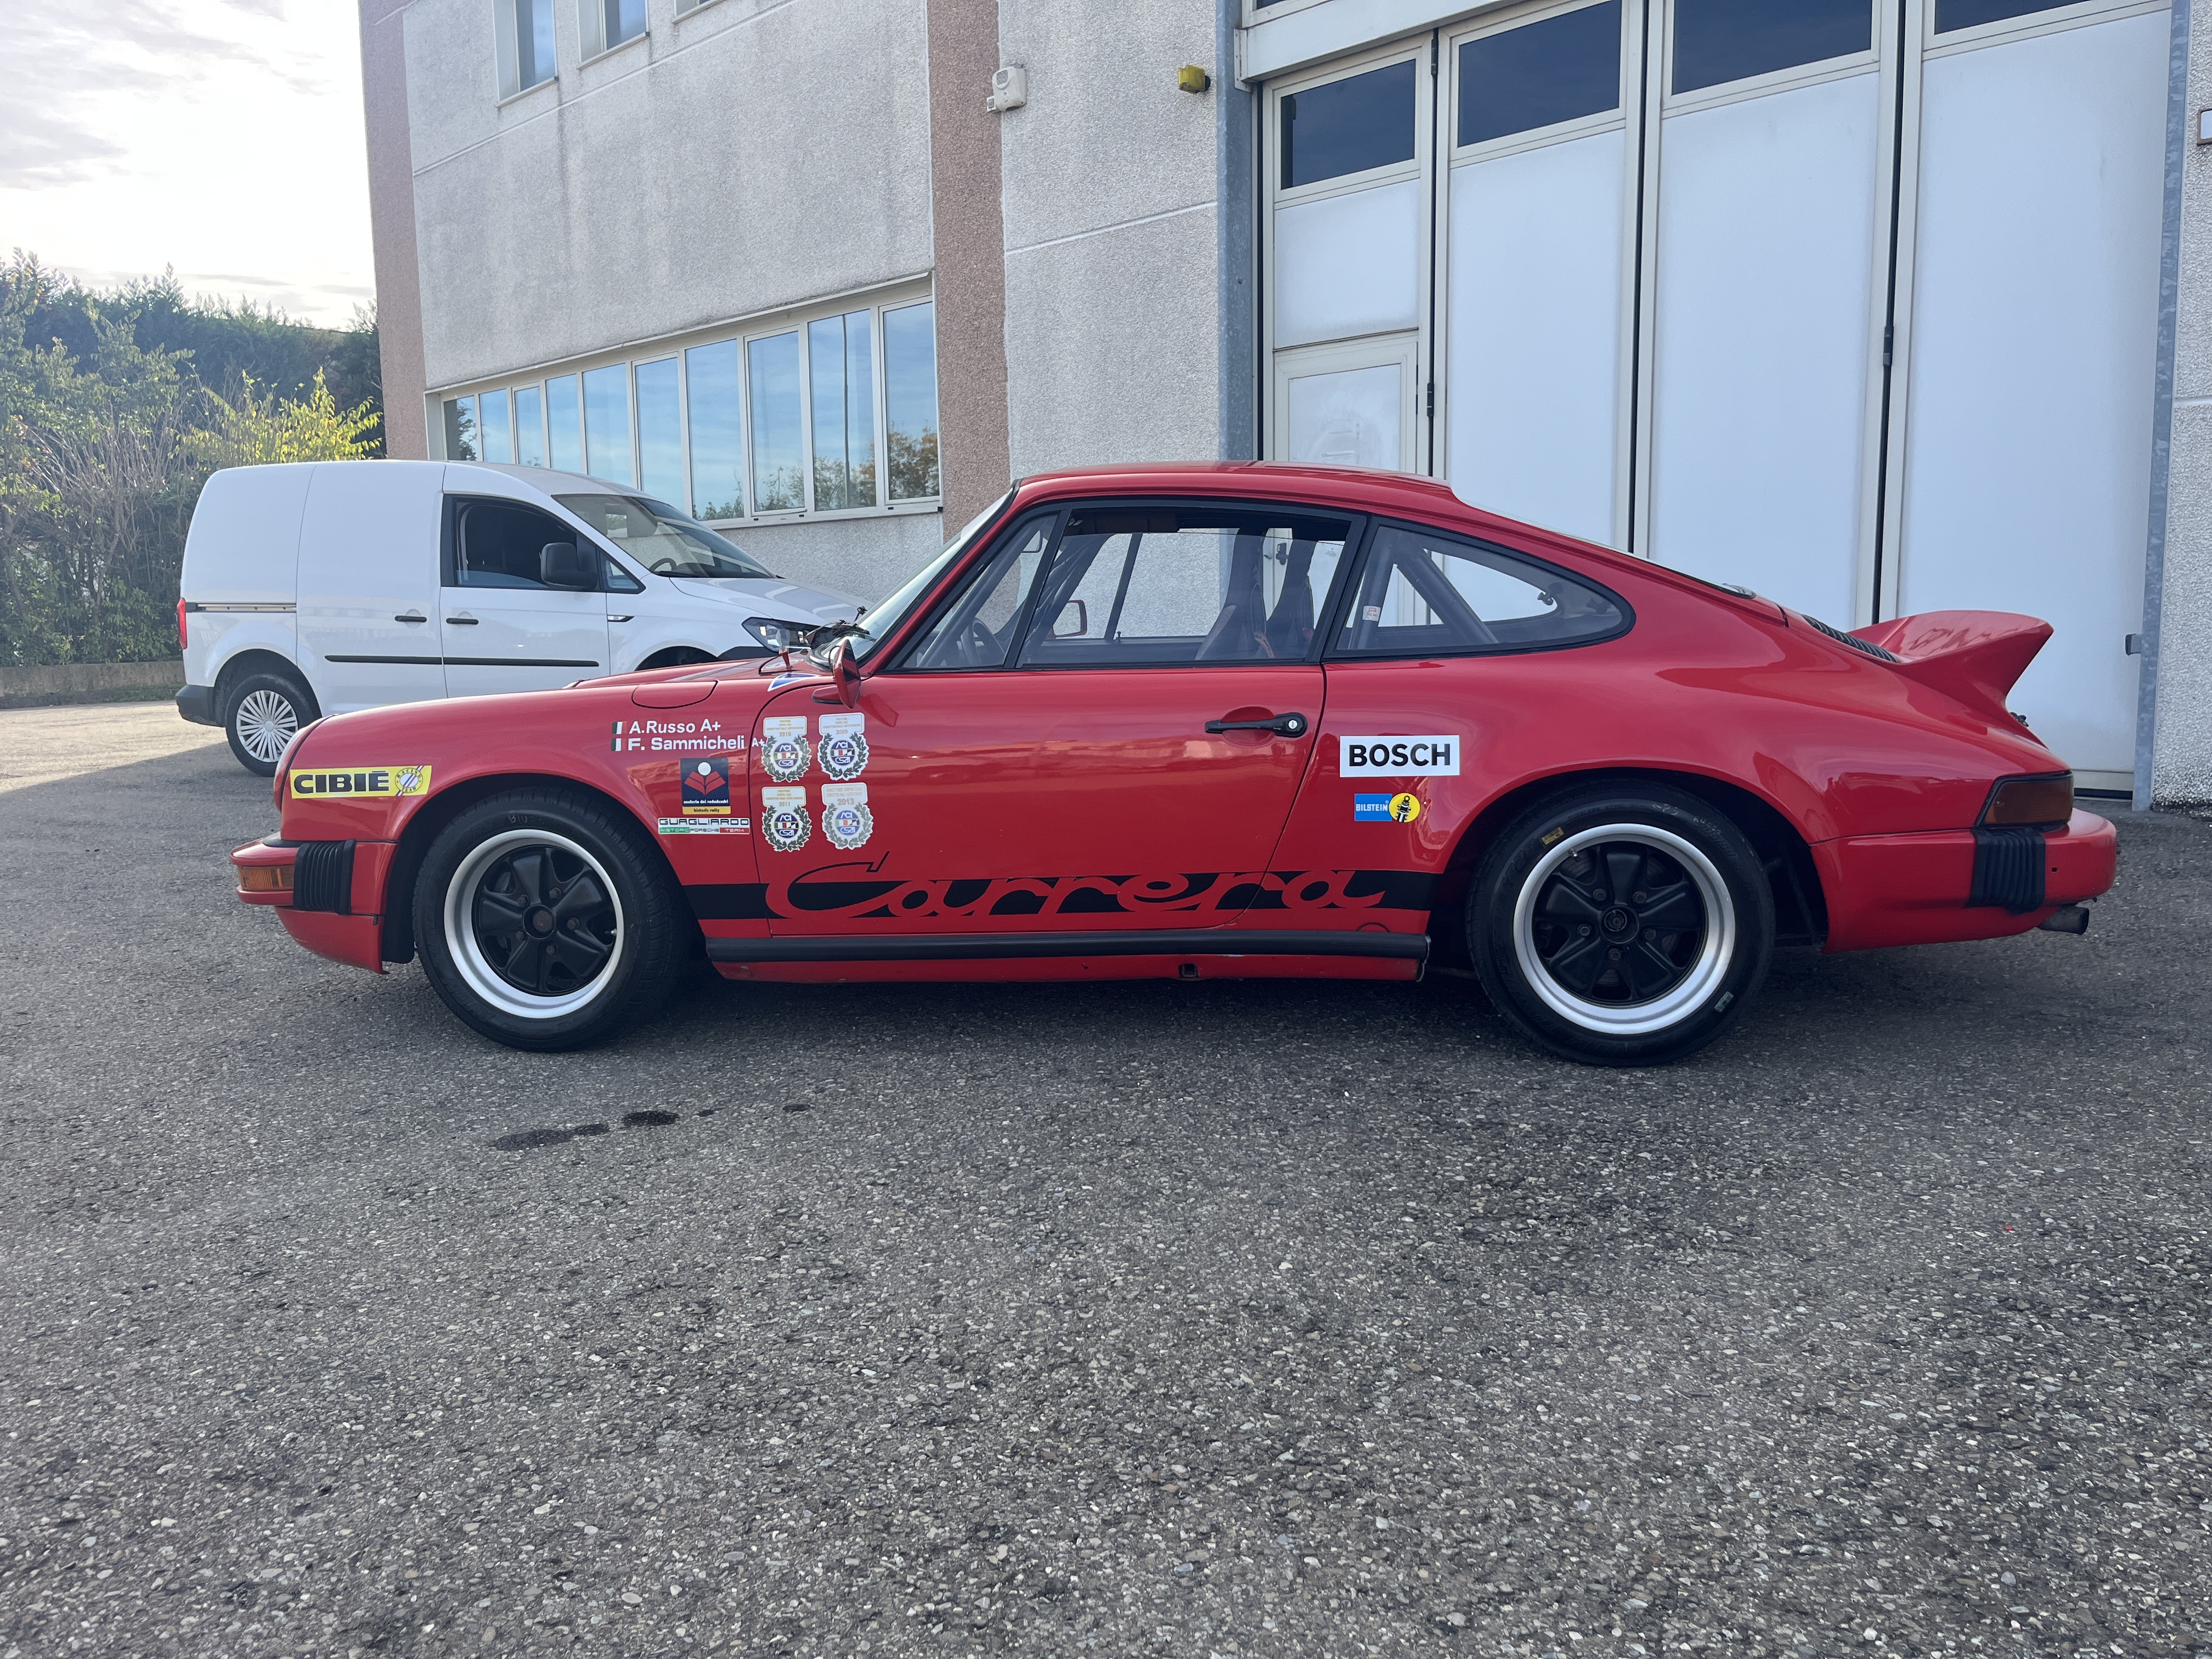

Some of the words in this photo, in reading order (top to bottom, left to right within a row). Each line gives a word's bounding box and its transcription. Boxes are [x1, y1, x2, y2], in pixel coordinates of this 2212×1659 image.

[629, 720, 696, 734] A.Russo
[700, 719, 721, 732] A+
[628, 738, 645, 751] F.
[651, 735, 744, 751] Sammicheli
[752, 737, 765, 747] A+
[1348, 743, 1451, 767] BOSCH
[396, 768, 422, 779] RACING
[765, 851, 1386, 919] Carrera
